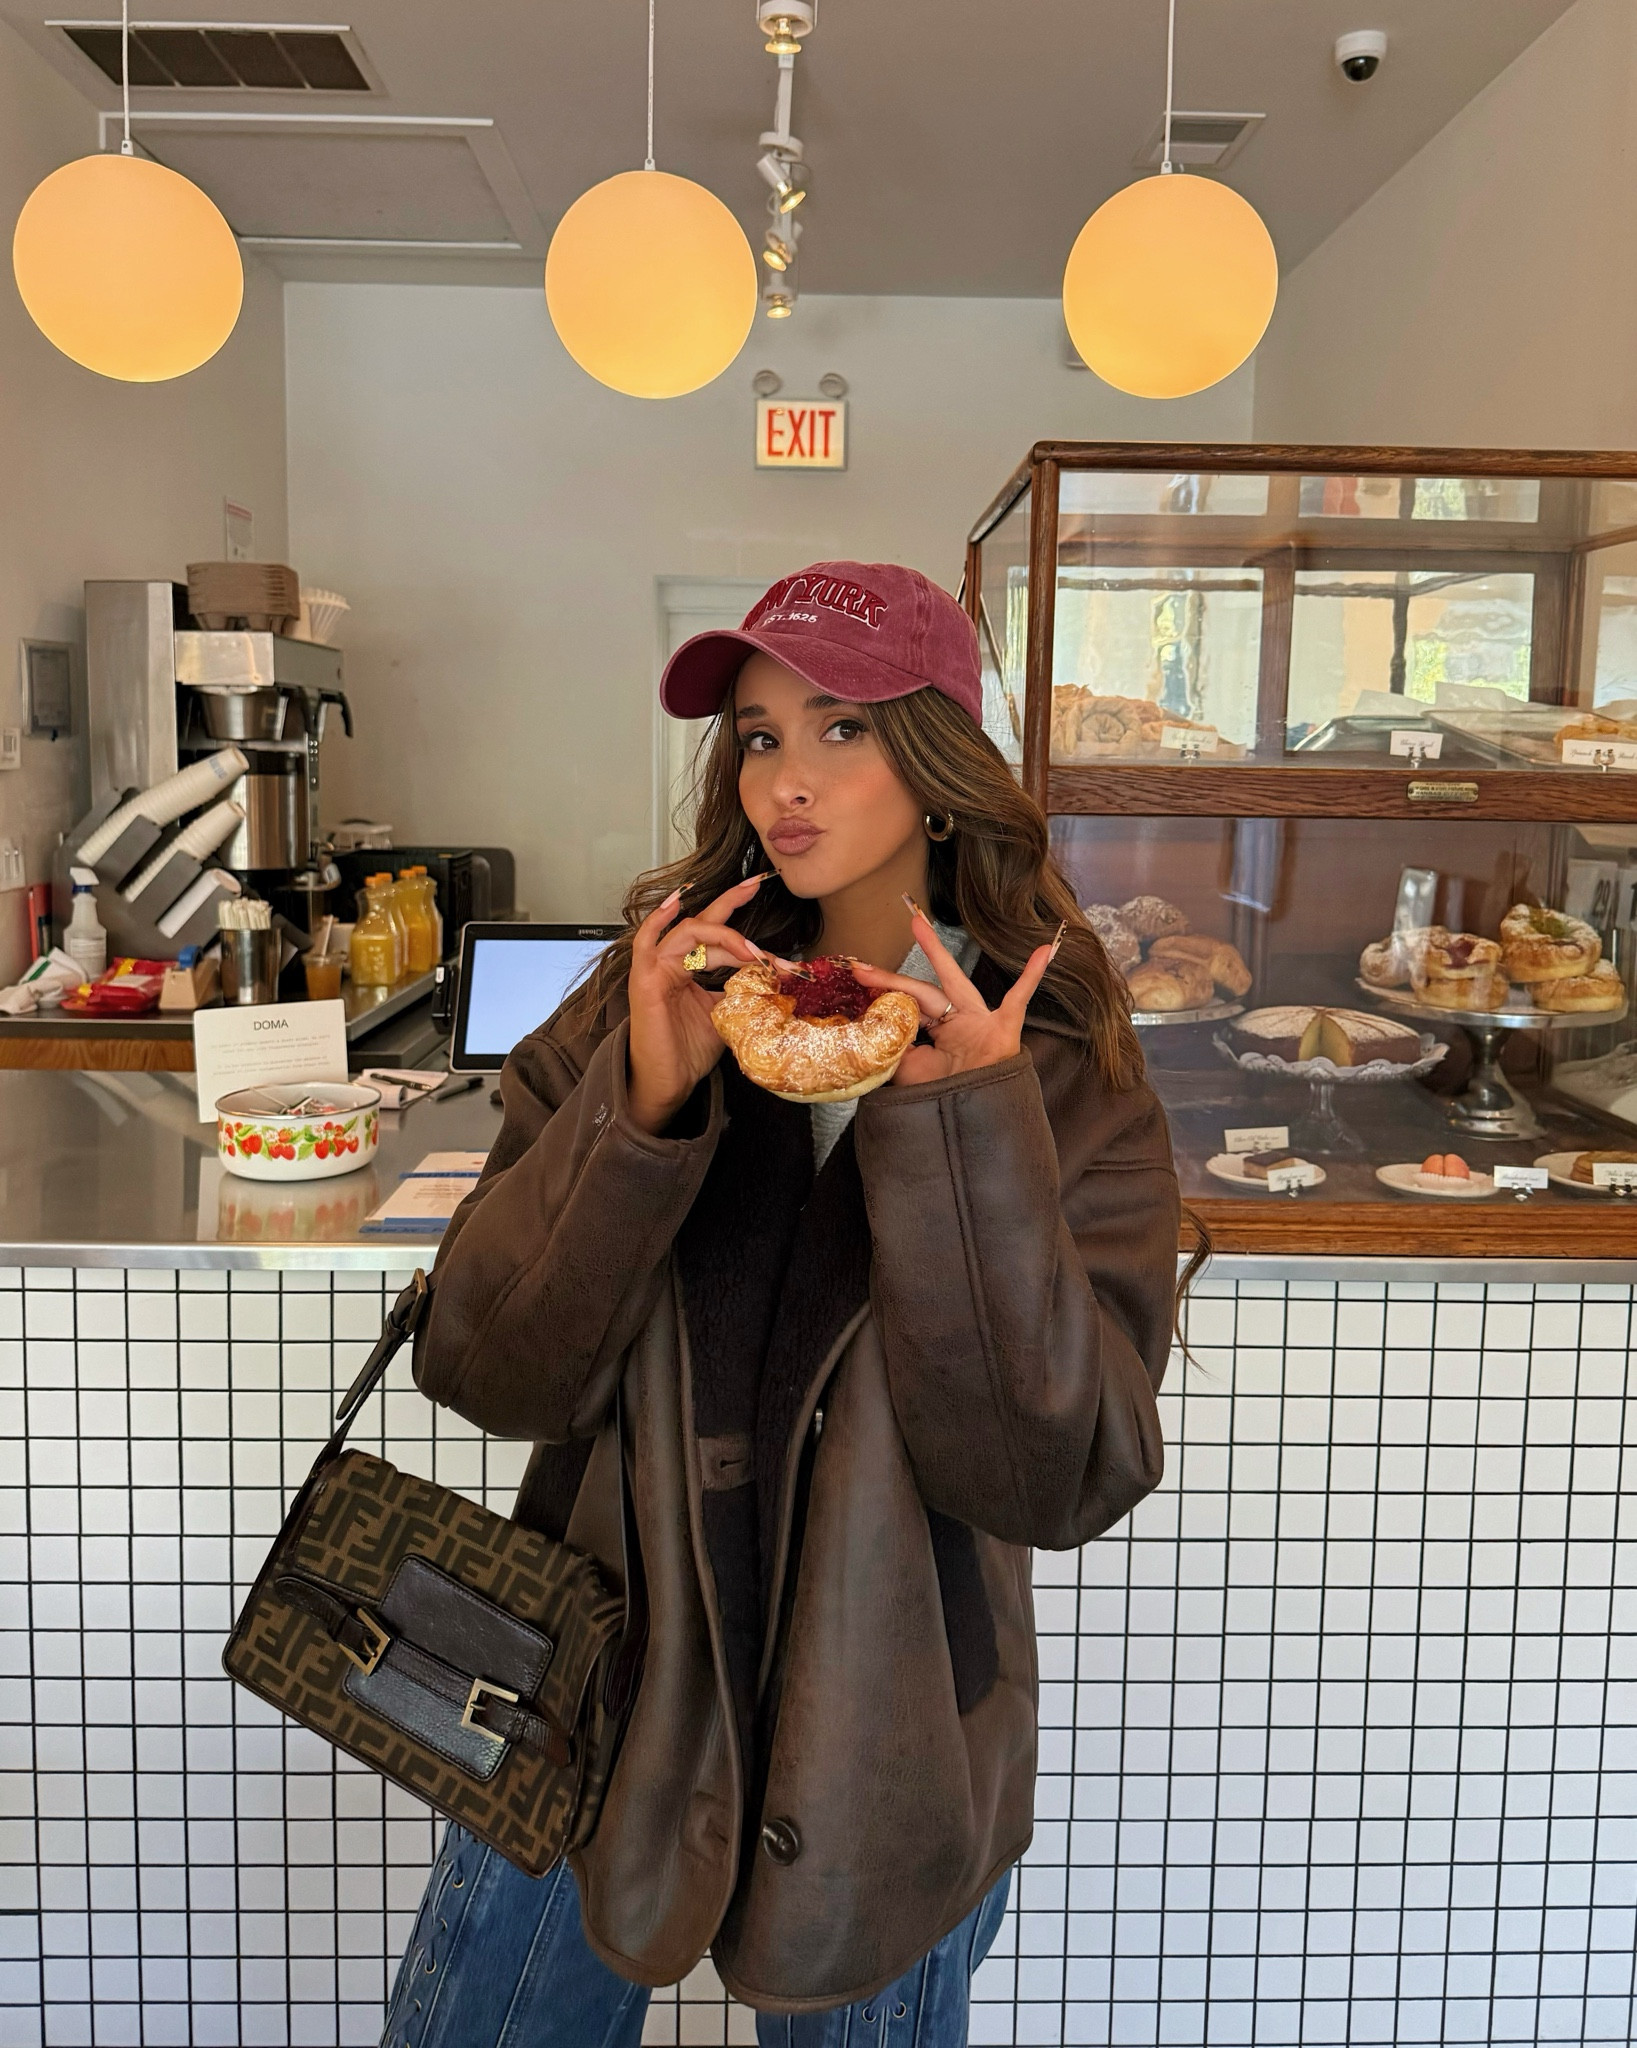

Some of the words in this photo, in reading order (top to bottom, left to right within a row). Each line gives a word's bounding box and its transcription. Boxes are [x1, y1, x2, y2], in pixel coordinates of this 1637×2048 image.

[767, 408, 836, 458] EXIT
[795, 573, 889, 630] YORK
[788, 612, 818, 623] 1625
[253, 1019, 289, 1031] DOMA
